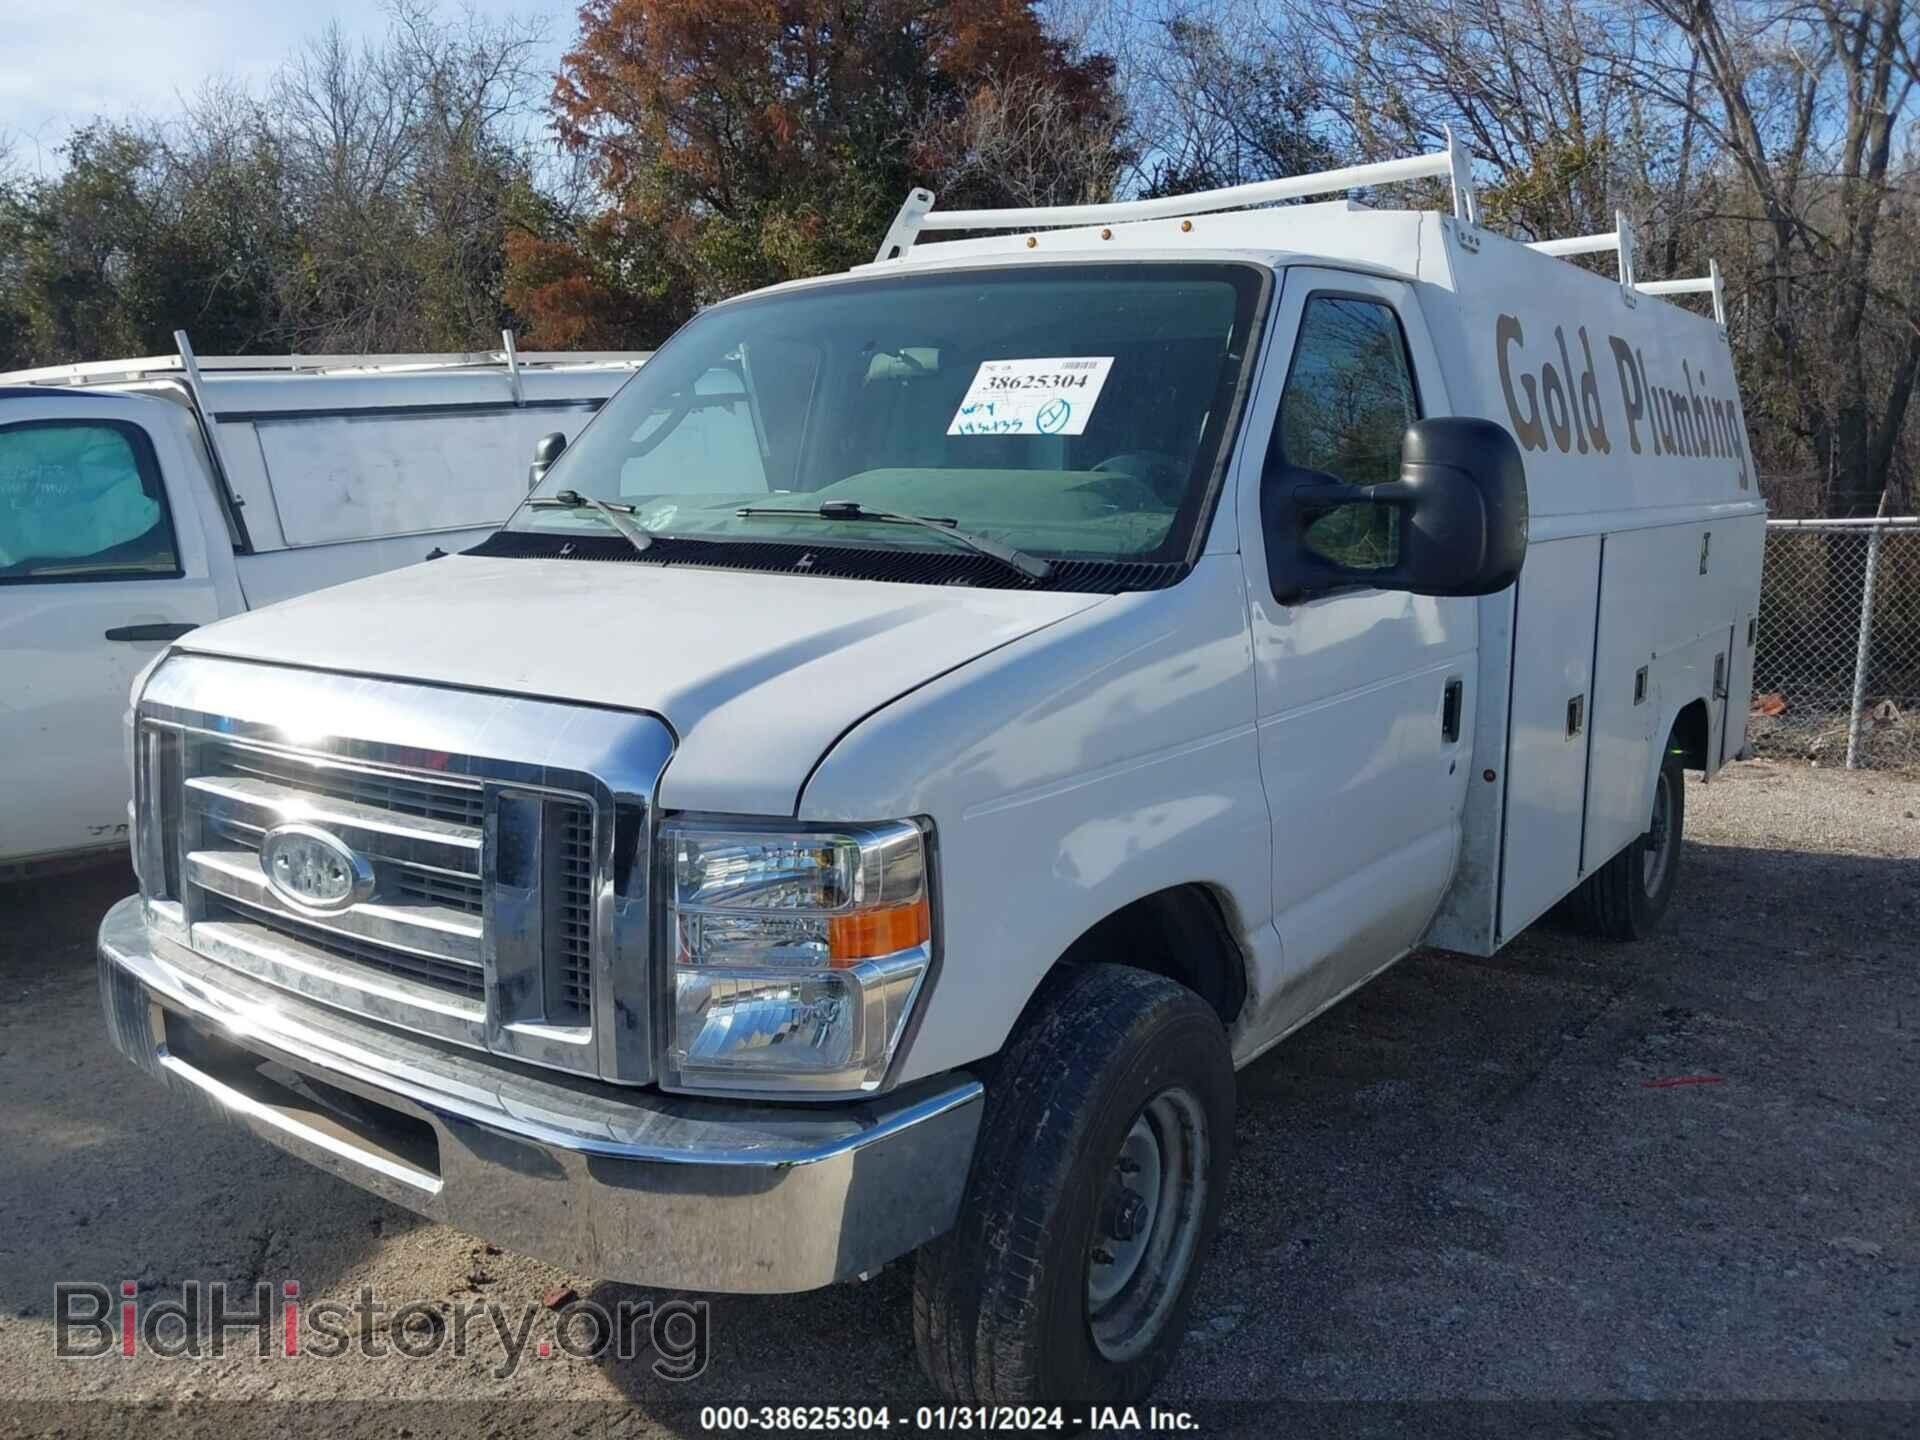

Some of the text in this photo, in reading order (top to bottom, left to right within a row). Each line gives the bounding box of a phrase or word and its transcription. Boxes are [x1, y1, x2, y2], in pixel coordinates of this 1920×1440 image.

[982, 375, 1088, 391] 38625304
[1496, 313, 1748, 490] Gold Plumbing
